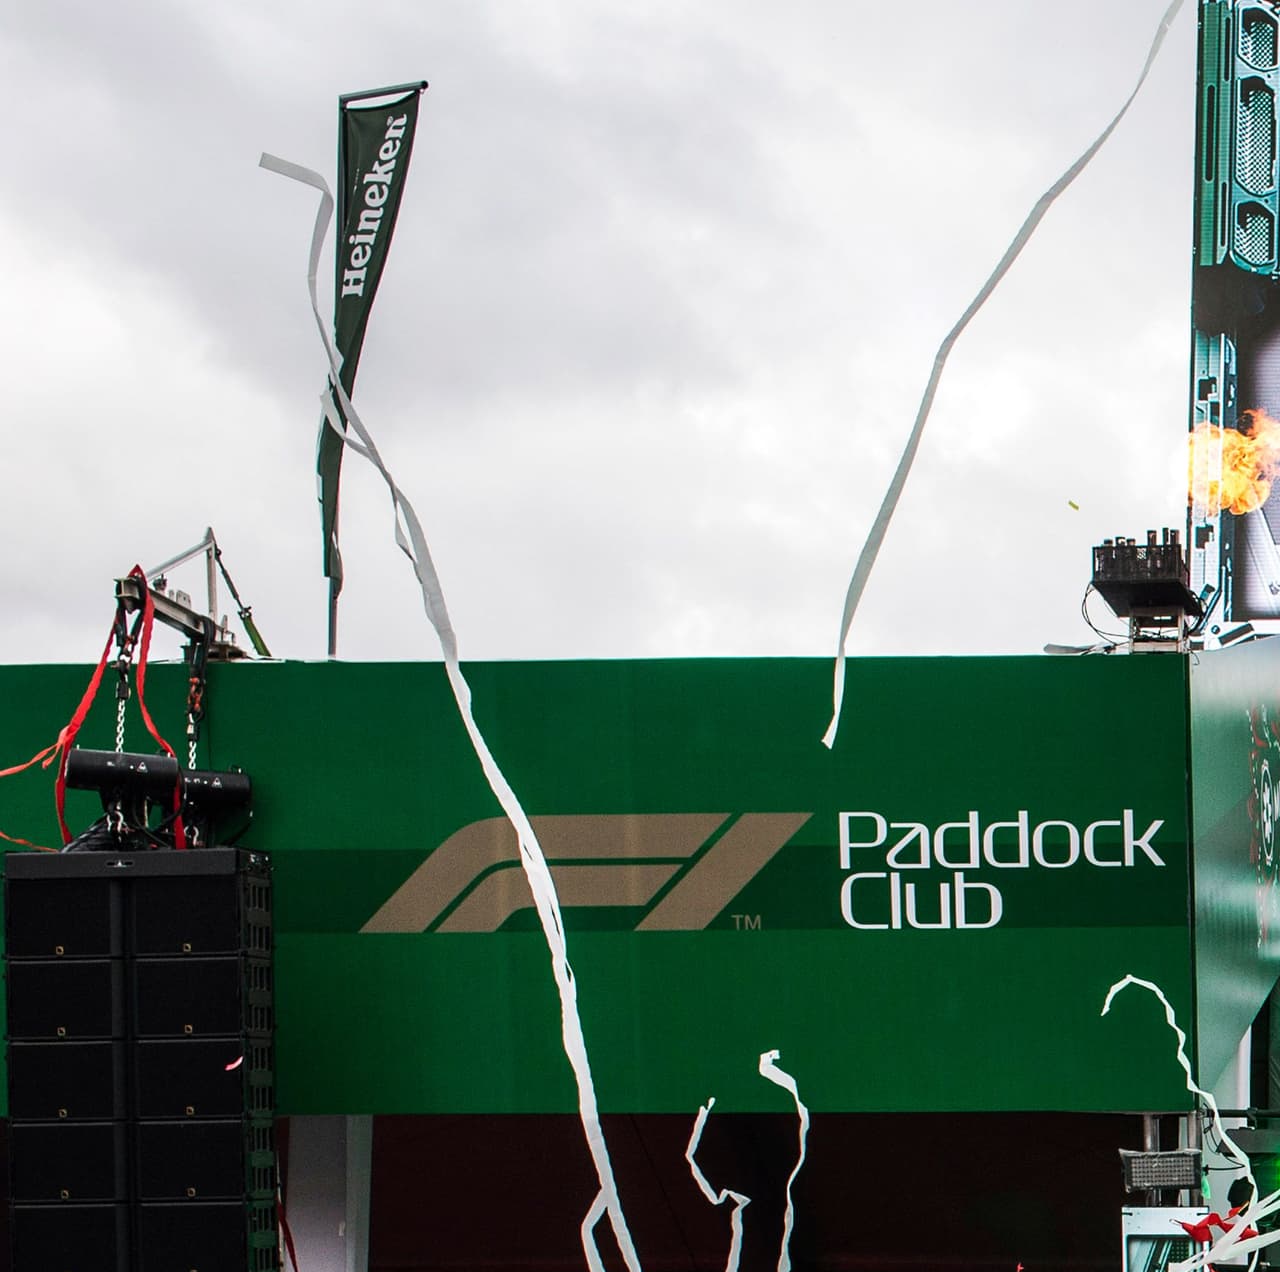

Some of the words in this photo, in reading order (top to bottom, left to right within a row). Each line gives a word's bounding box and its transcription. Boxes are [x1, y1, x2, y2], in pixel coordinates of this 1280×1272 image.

[341, 113, 408, 298] Heineken
[838, 808, 1166, 870] Paddock
[840, 872, 1004, 930] Club
